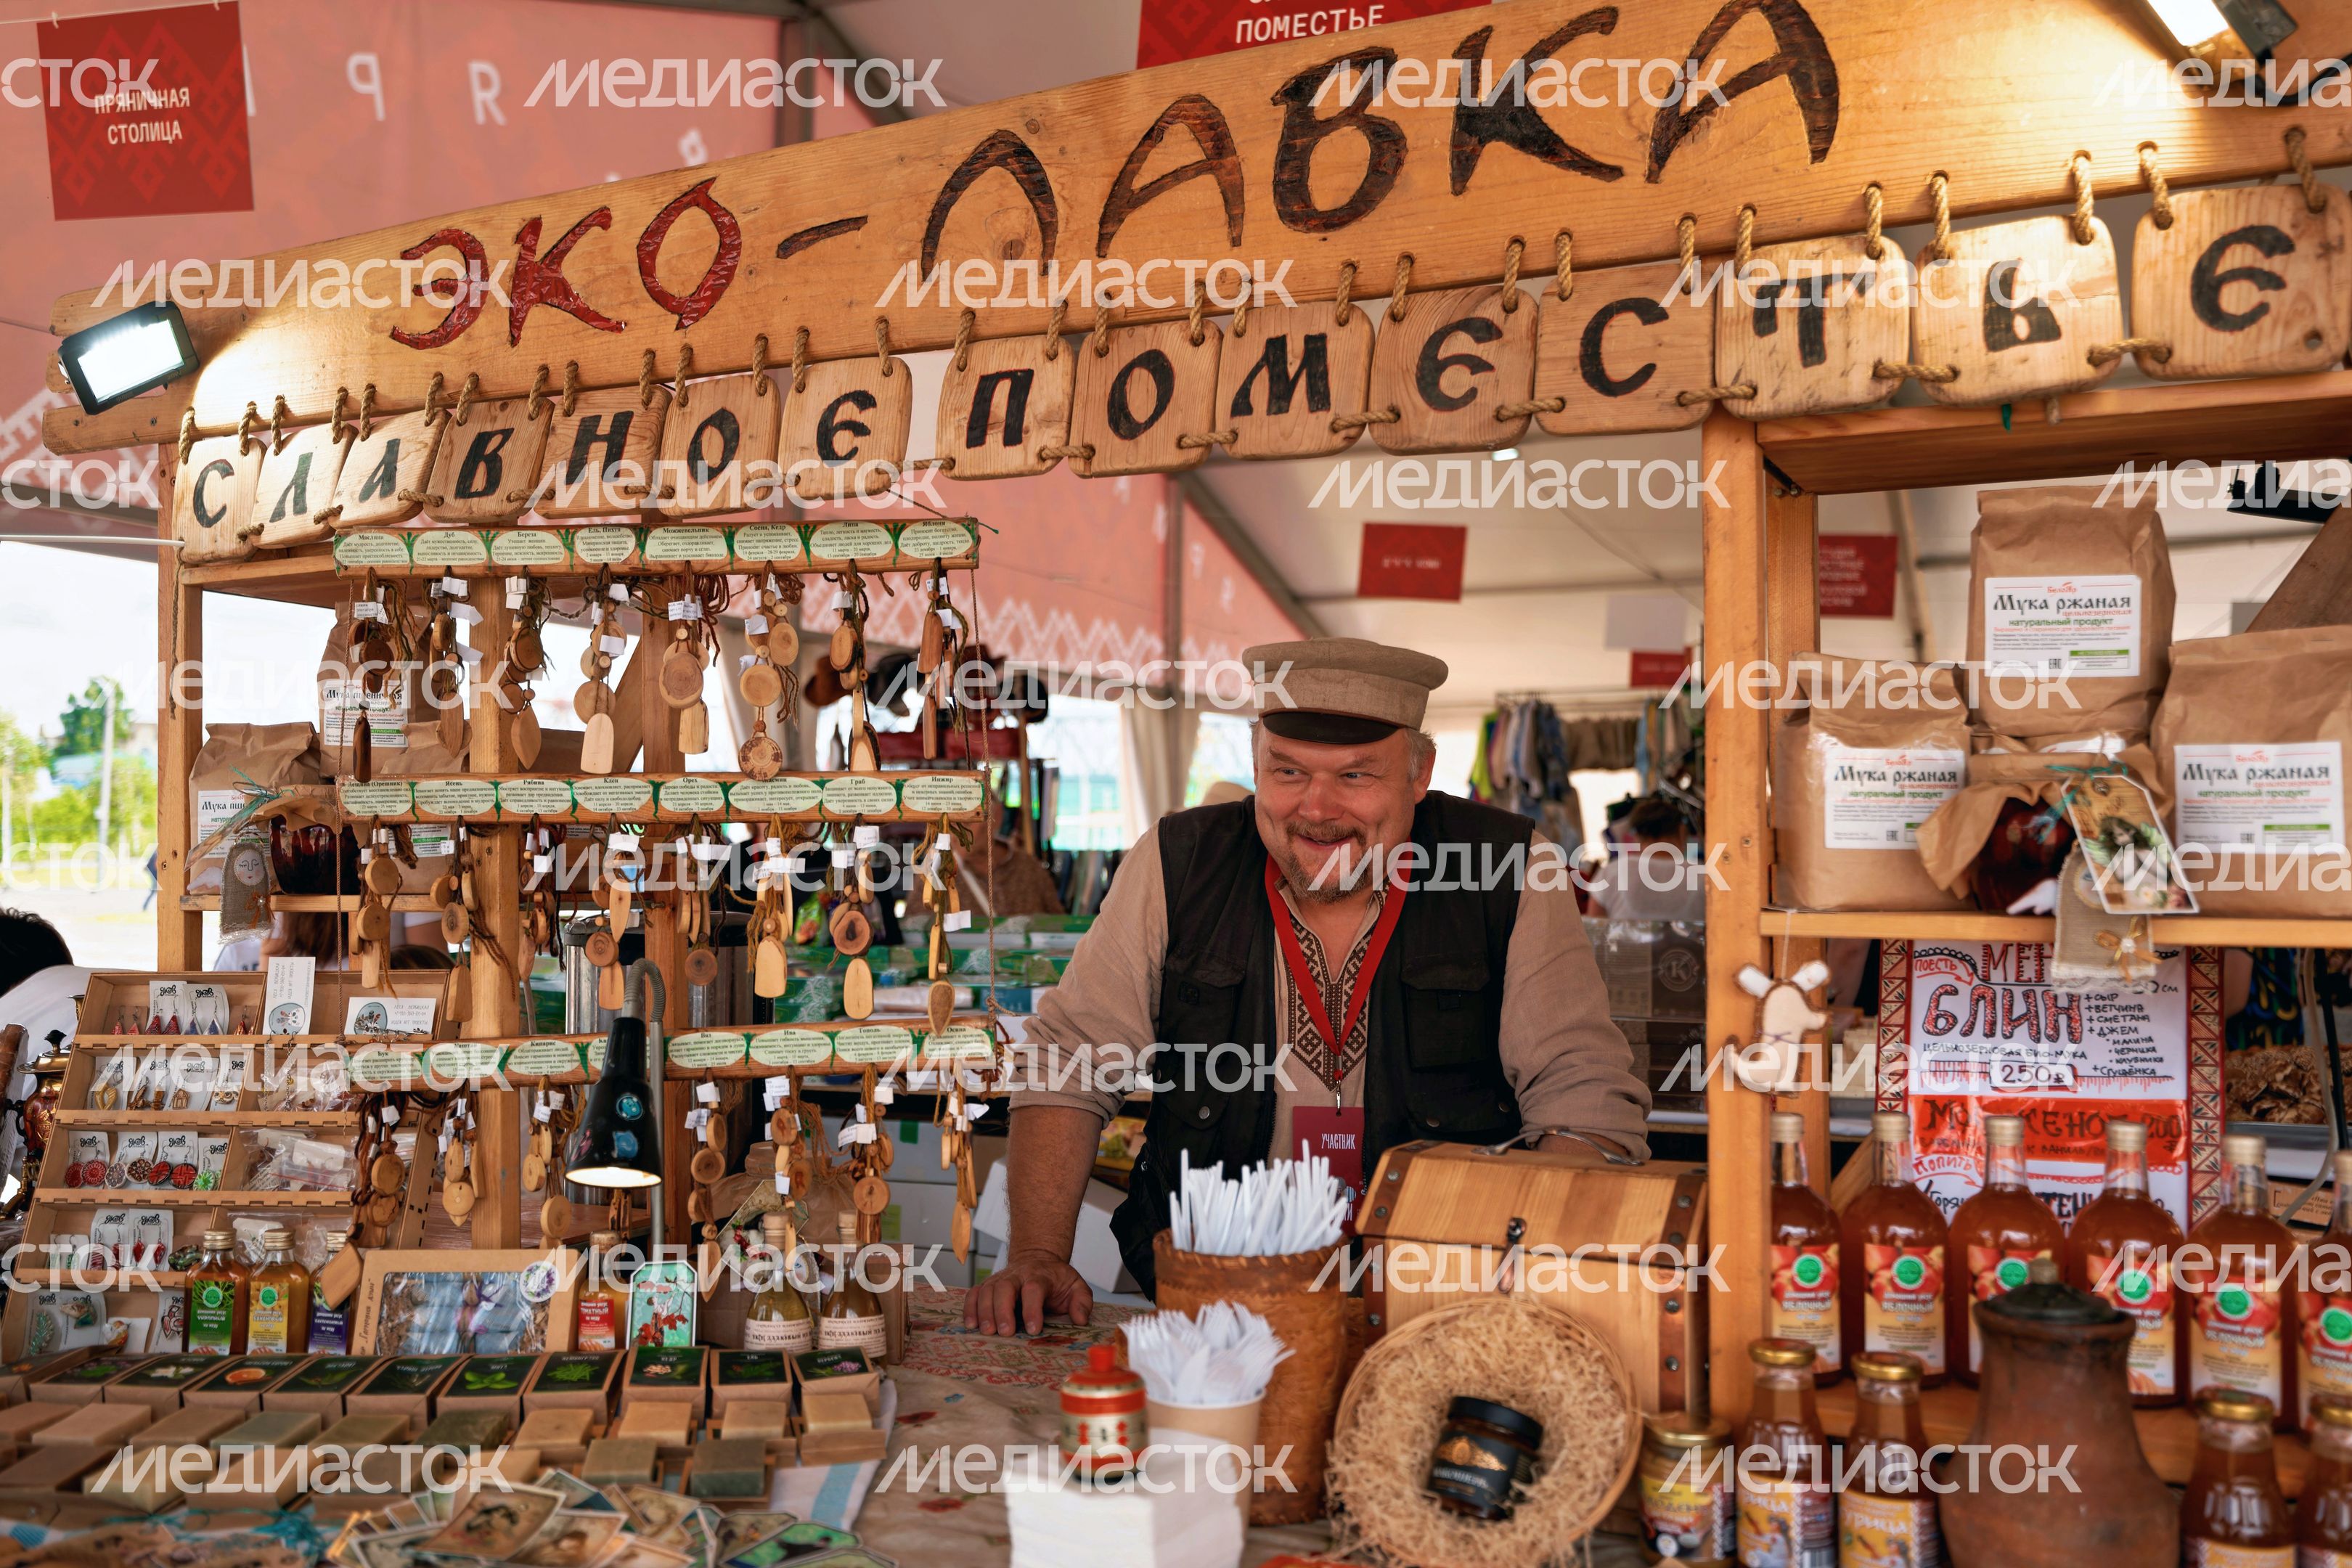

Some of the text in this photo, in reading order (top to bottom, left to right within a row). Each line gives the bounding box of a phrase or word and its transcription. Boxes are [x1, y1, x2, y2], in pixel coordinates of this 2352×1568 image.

[1236, 4, 1385, 44] ПОМЕСТЬЕ
[94, 86, 191, 115] ПРЯНИЧНАЯ
[107, 119, 183, 145] СТОЛИЦА
[1993, 595, 2133, 616] Мука ржаная
[2009, 616, 2114, 627] натуральный продукт
[1834, 766, 1958, 787] Мука ржаная
[2182, 763, 2330, 786] Мука ржаная
[1848, 790, 1944, 800] натуральный продукт
[2266, 789, 2311, 799] продукт
[202, 801, 227, 813] Мука
[1914, 957, 1959, 972] ПОЕСТЬ
[1922, 984, 2082, 1045] БЛИН
[1321, 1132, 1357, 1151] УЧАСТНИК
